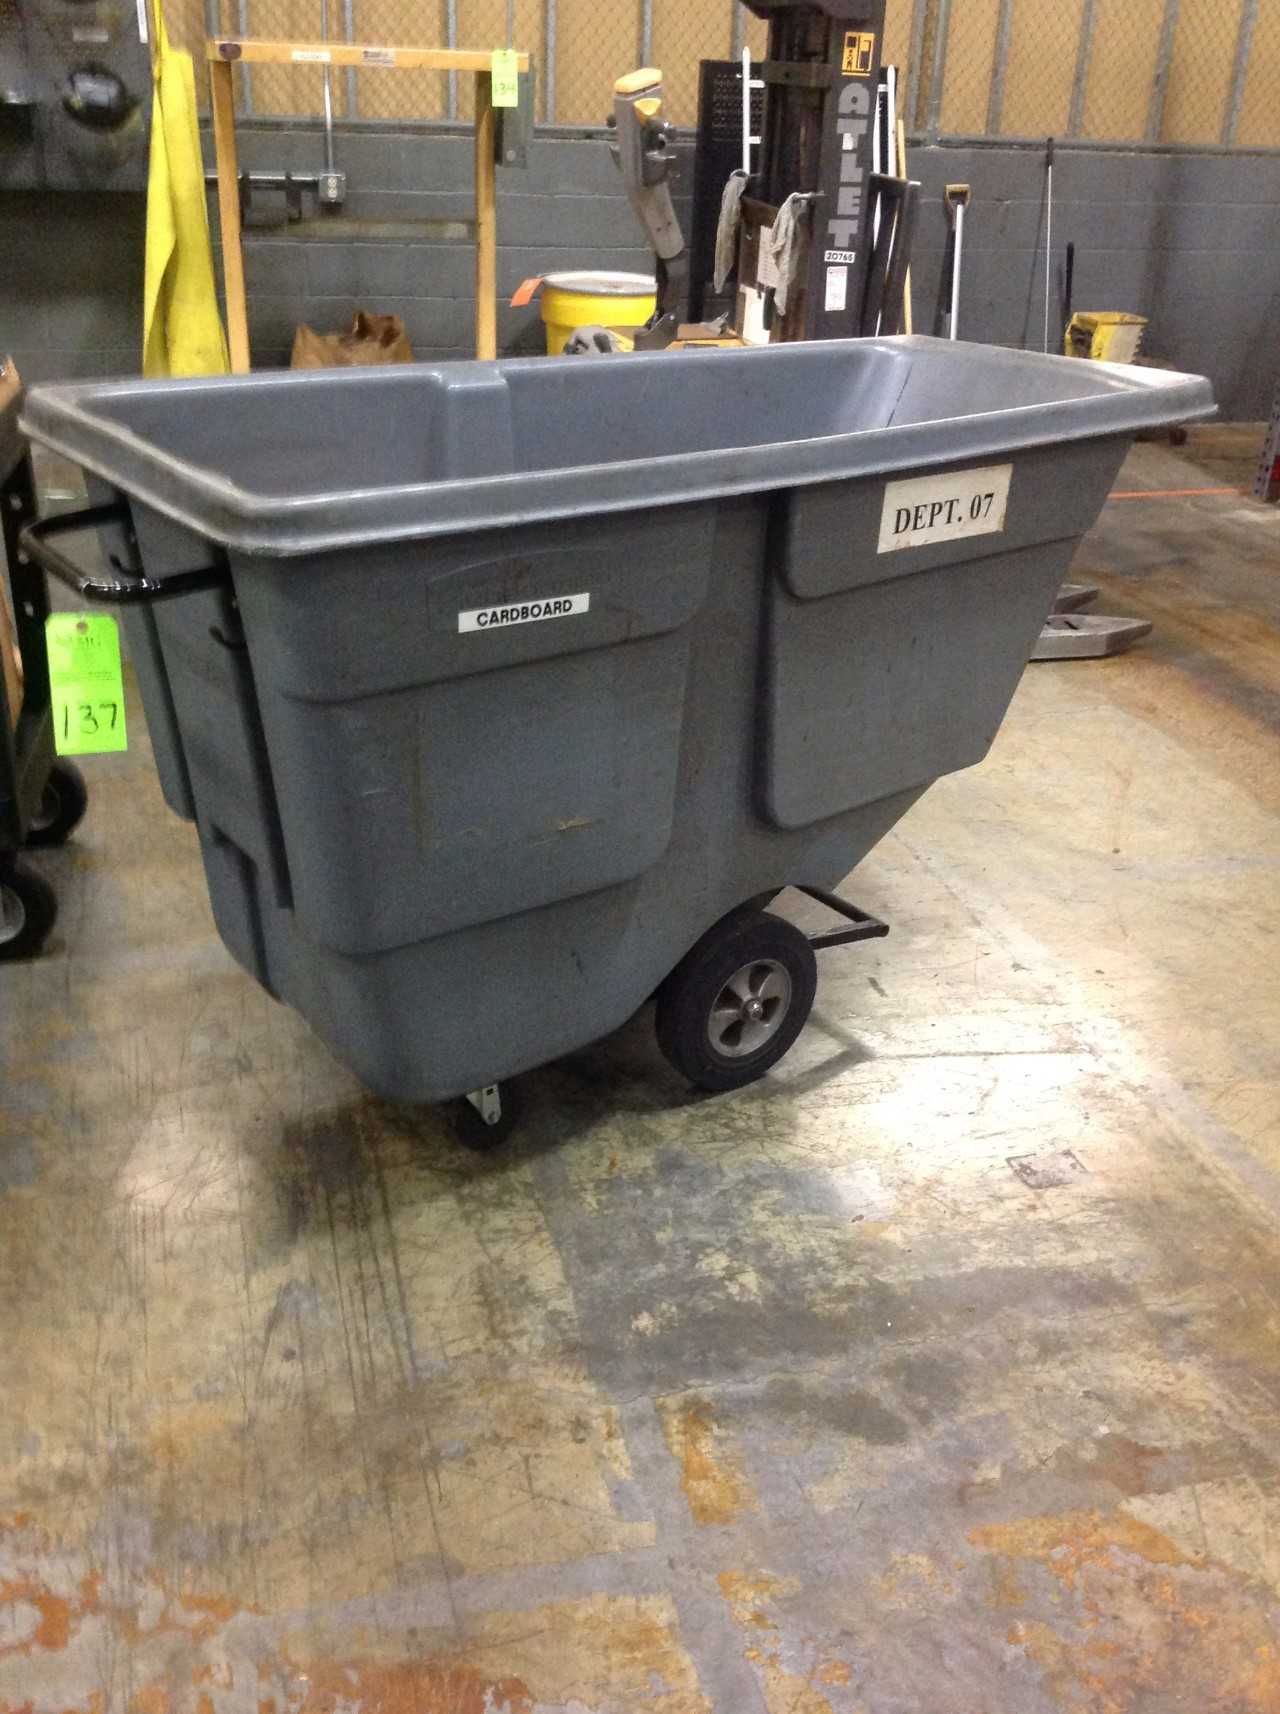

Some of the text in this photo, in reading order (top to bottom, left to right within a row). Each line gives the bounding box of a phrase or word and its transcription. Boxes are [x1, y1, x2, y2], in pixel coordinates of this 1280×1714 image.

[828, 82, 870, 248] ATLET
[893, 493, 994, 535] DEPT. 07
[477, 599, 573, 627] CARDBOARD
[64, 703, 118, 740] 137
